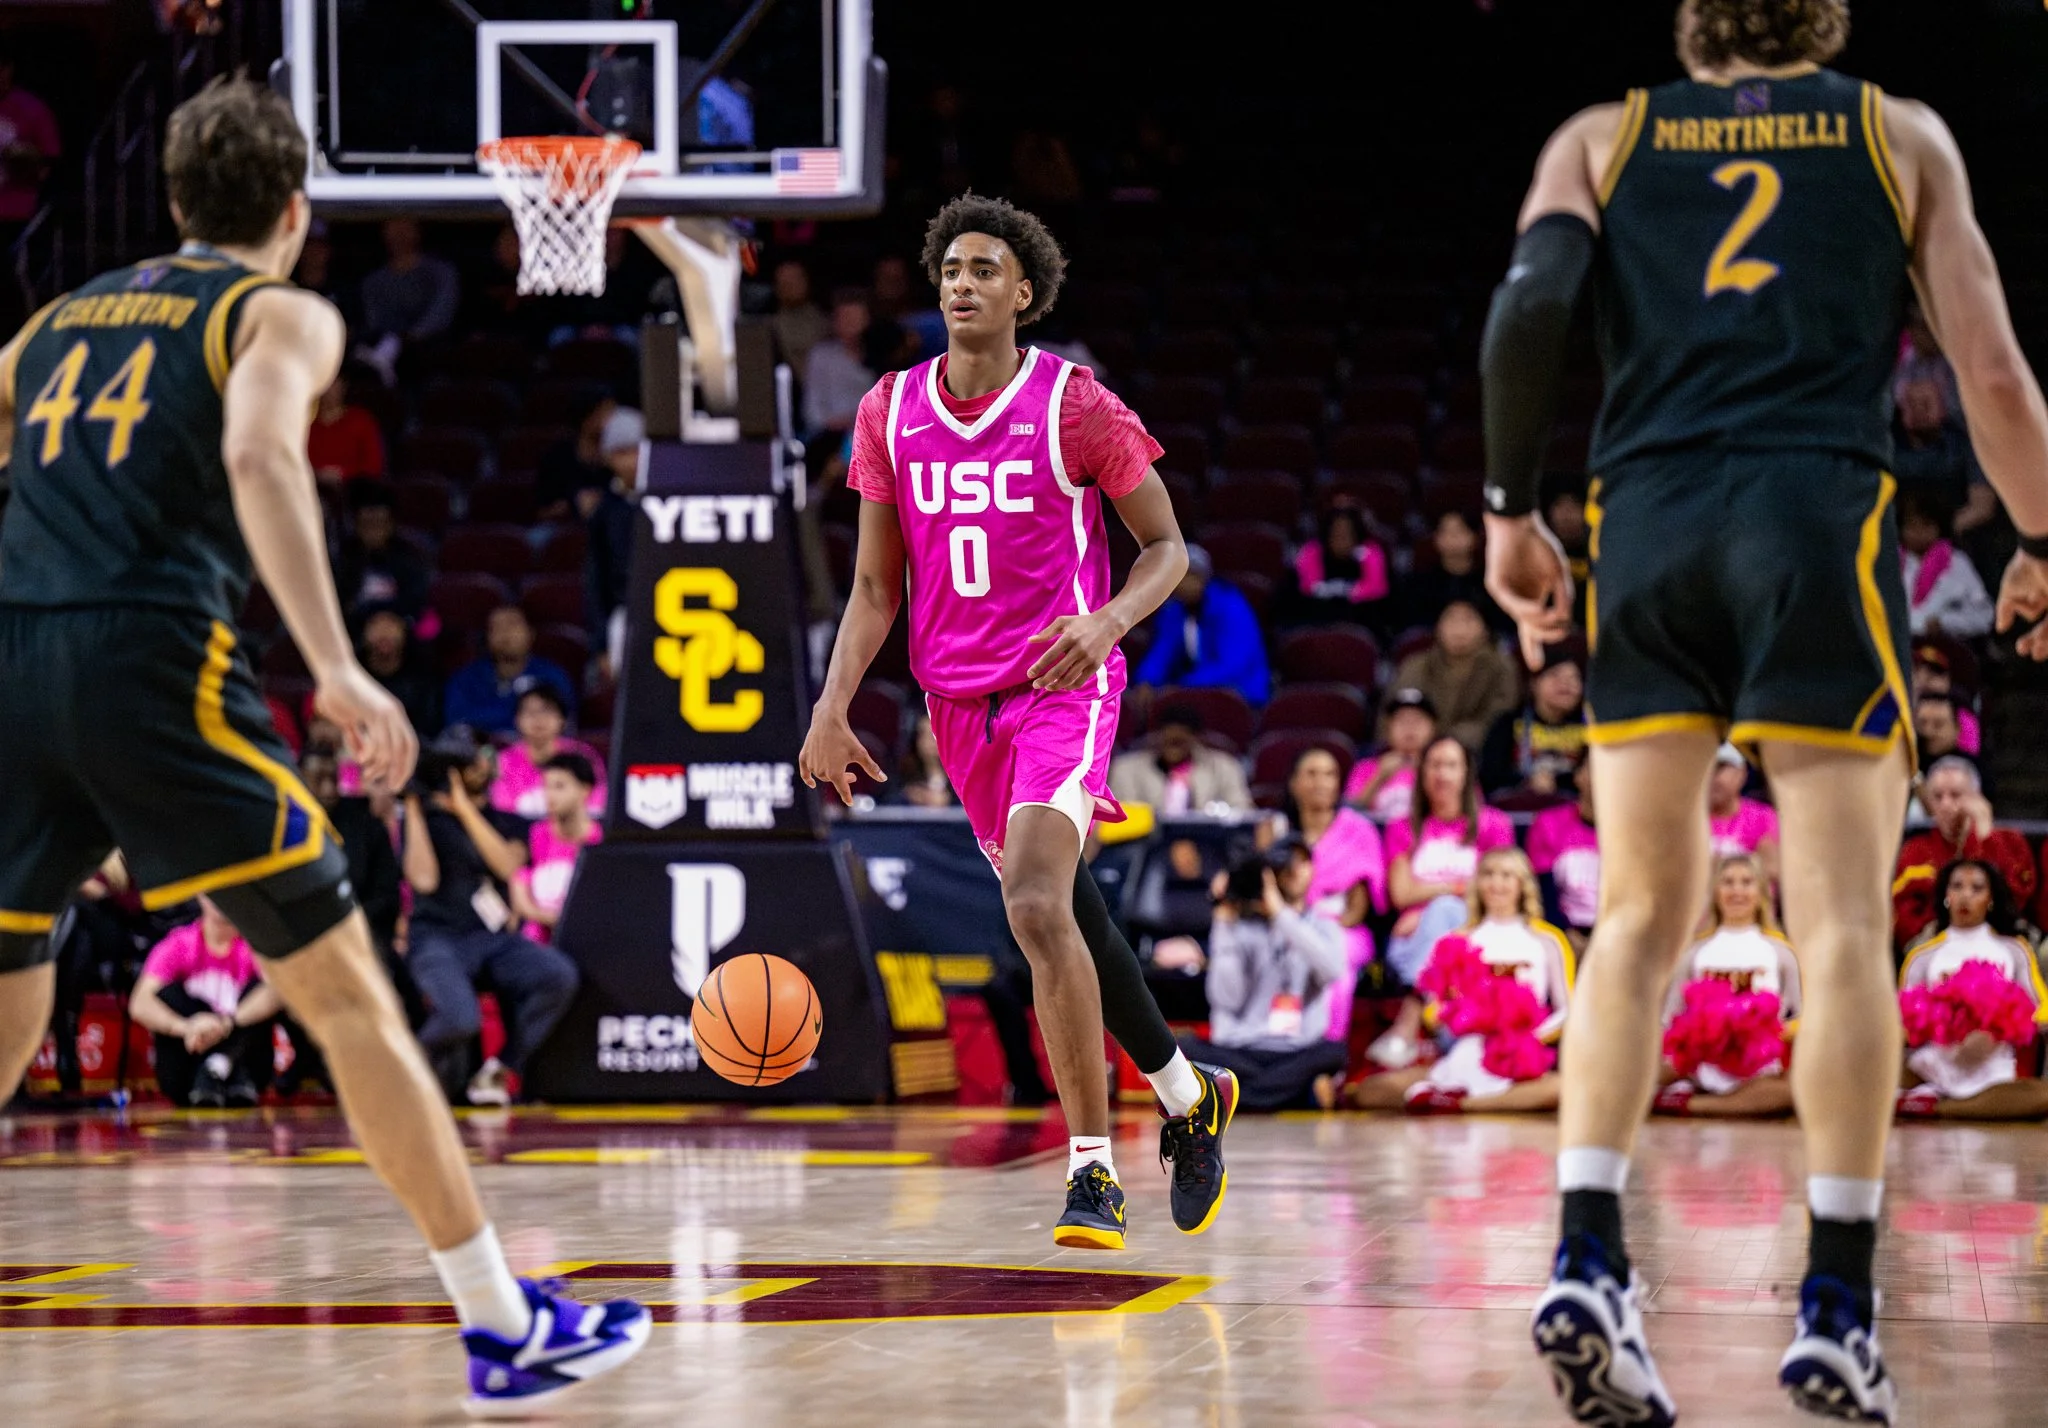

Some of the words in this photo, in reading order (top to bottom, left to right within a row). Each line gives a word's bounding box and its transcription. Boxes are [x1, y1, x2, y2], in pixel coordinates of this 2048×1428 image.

[1653, 112, 1848, 152] MARTINELLI
[1703, 158, 1784, 300] 2
[24, 336, 158, 470] 44
[908, 459, 1035, 515] USC
[641, 495, 778, 543] YETI
[949, 525, 991, 598] 0
[687, 762, 795, 801] MUSCLE
[704, 795, 776, 830] MILK
